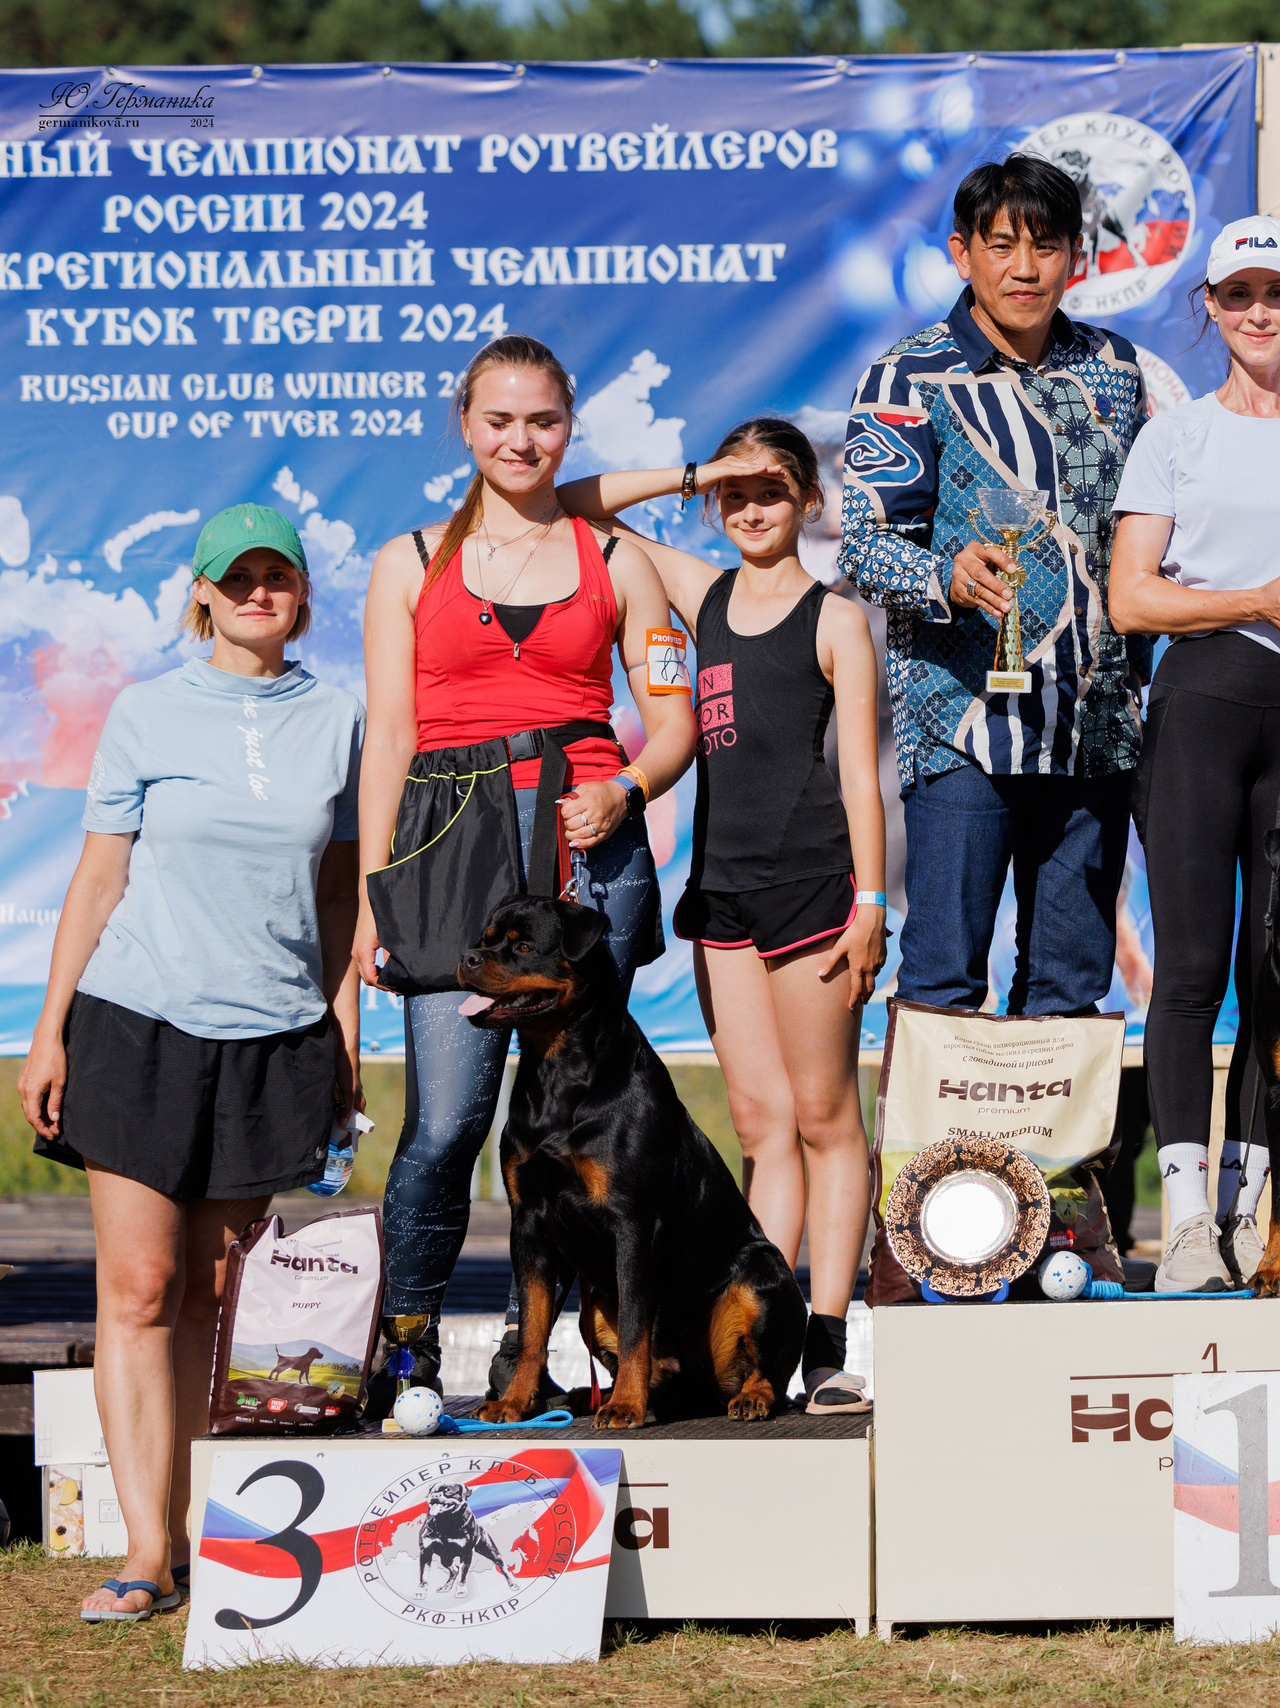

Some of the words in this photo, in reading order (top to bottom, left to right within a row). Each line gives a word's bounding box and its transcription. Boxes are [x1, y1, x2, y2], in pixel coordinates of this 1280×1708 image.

[1085, 119, 1152, 150] КЛУБ
[129, 134, 462, 177] ЧЕМПИОНАТ
[477, 123, 839, 174] РОТВЕЙЛЕРОВ
[102, 193, 305, 233] РОССИИ
[320, 190, 430, 232] 2024
[1235, 236, 1278, 251] FILA
[450, 242, 787, 287] ЧЕМПИОНАТ
[25, 307, 197, 348] КУБОК
[213, 304, 384, 346] ТВЕРИ
[399, 302, 509, 343] 2024
[20, 374, 172, 405] RUSSIAN
[181, 371, 275, 401] CLUB
[285, 371, 427, 400] WINNER
[107, 411, 179, 440] CUP
[188, 411, 235, 440] OF
[243, 411, 340, 438] TVER
[350, 410, 424, 437] 2024
[702, 727, 738, 756] OTO
[968, 1055, 1018, 1069] говядиной
[1024, 1057, 1055, 1069] рисом
[938, 1078, 1073, 1104] Hanta
[977, 1106, 1031, 1115] premium
[270, 1249, 359, 1275] Hanta
[358, 1462, 452, 1584] РОТВЕЙЛЕР
[468, 1458, 541, 1486] КЛУБ
[543, 1488, 573, 1581] РОССИИ
[215, 1460, 325, 1630] 3
[400, 1597, 522, 1627] РКФ-НКПР
